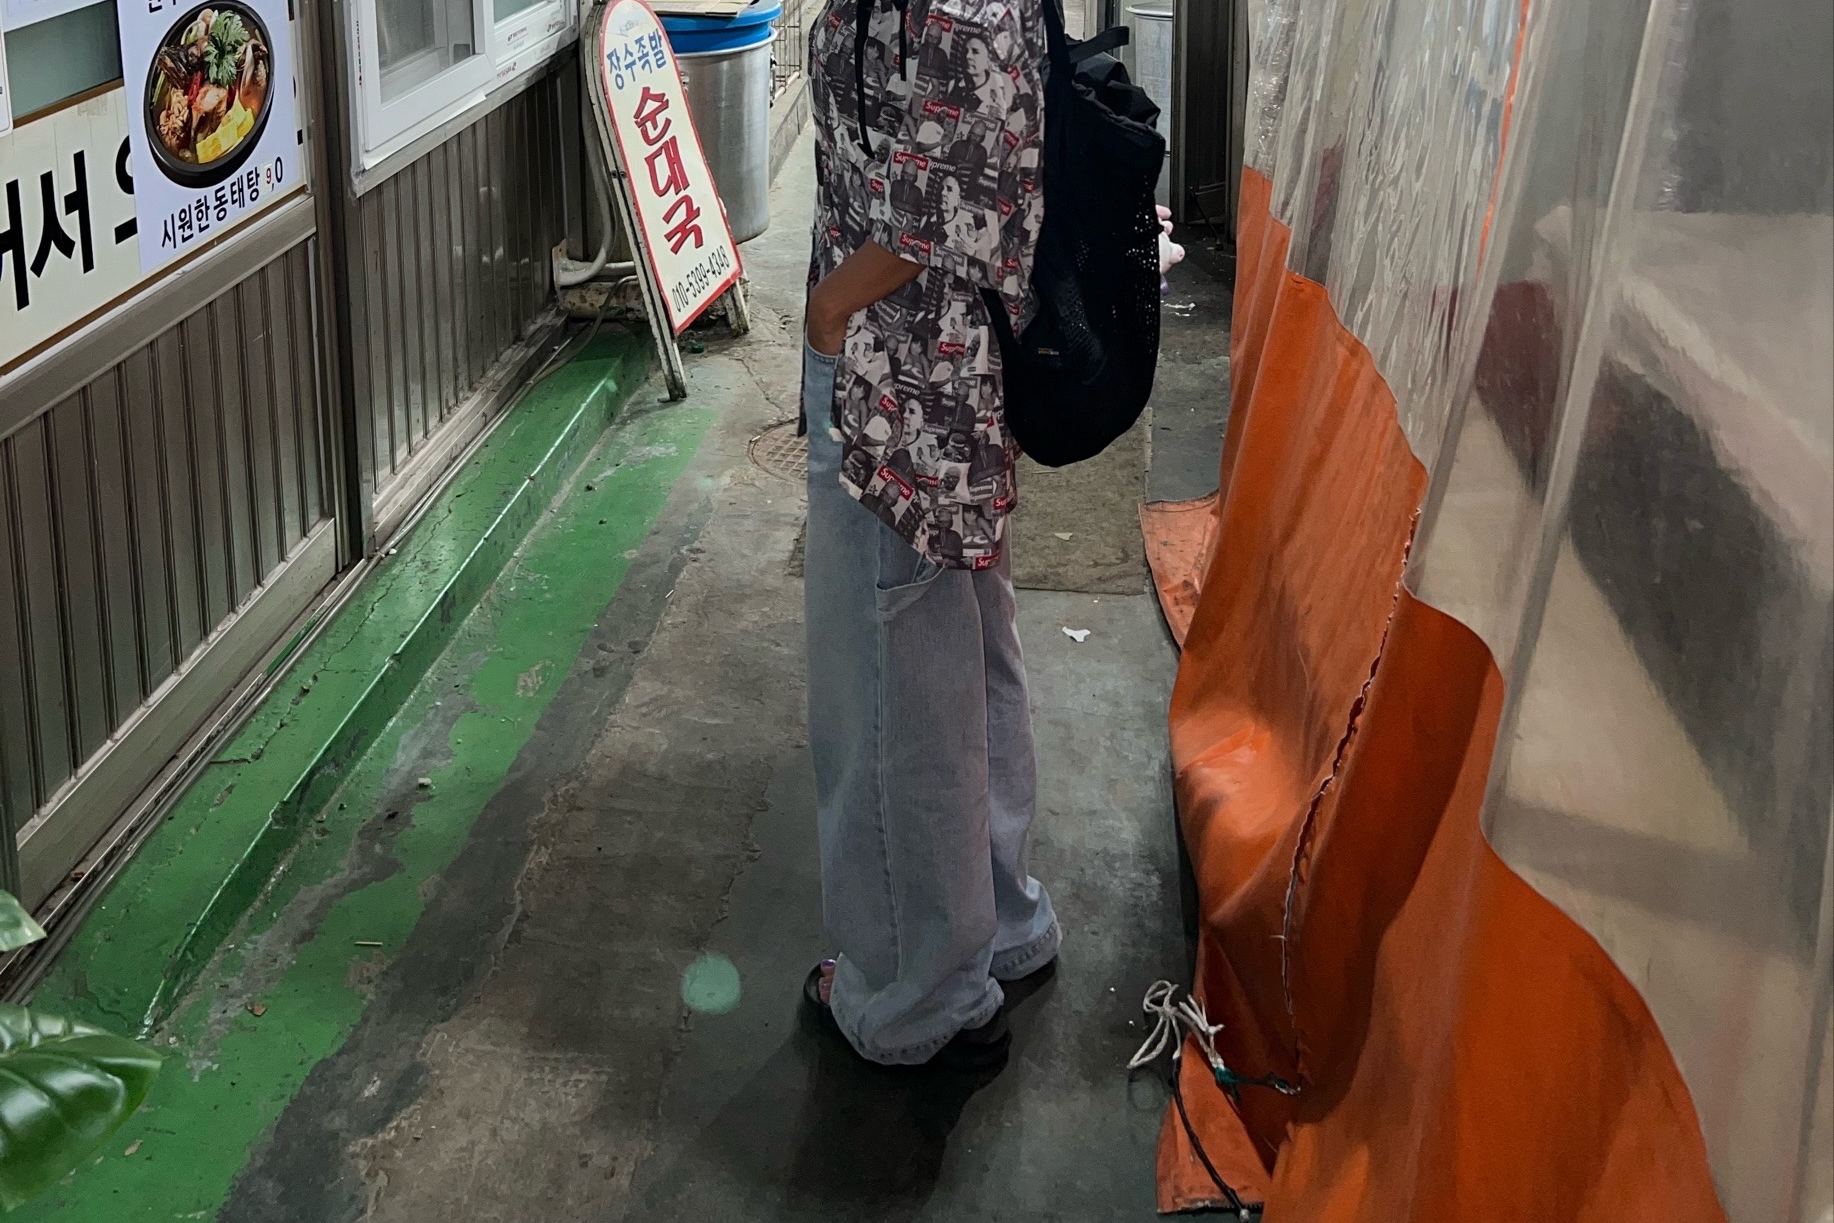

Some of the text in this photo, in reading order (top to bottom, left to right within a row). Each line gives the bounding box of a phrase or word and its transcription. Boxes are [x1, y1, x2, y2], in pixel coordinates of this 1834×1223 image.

[606, 27, 667, 90] 장수족발
[632, 86, 704, 255] 순대국
[672, 244, 730, 313] 010-5399-4348
